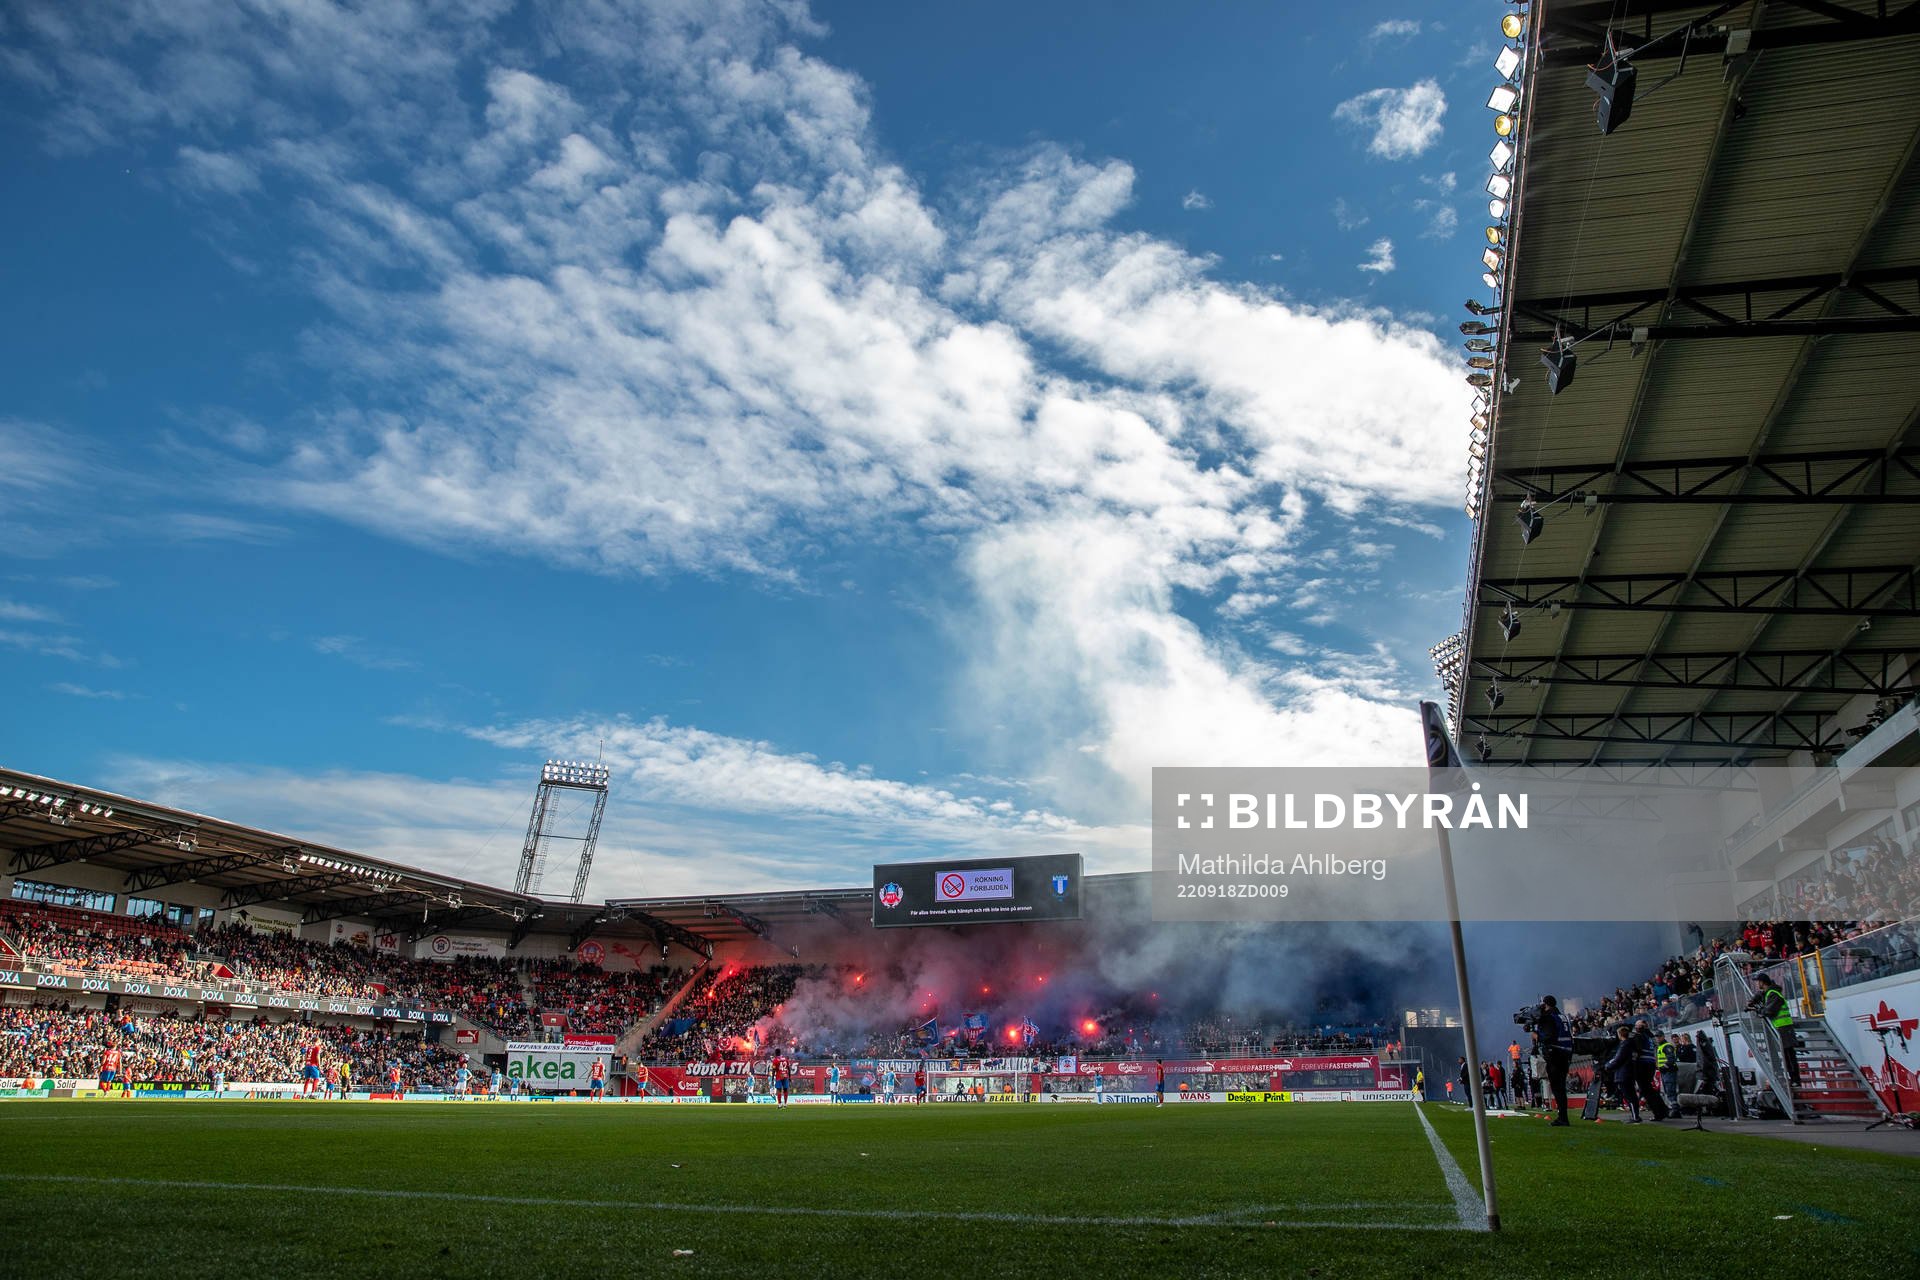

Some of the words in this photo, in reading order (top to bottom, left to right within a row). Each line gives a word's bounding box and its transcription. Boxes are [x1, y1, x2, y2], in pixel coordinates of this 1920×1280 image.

[0, 971, 20, 984] OXA
[38, 974, 67, 988] DOXA
[82, 978, 110, 991] DOXA
[125, 982, 151, 994] DOXA
[164, 986, 188, 998] DOXA
[202, 990, 224, 1001] DOXA
[236, 994, 258, 1004] DOXA
[269, 997, 290, 1008] DOXA
[300, 1000, 318, 1010] DOXA
[329, 1003, 348, 1013] DOXA
[357, 1006, 374, 1016] DOXA
[384, 1008, 400, 1018] DOXA
[408, 1010, 424, 1020] DOXA
[433, 1013, 448, 1022] DOXA
[107, 1053, 117, 1063] 44
[507, 1055, 576, 1080] akea
[779, 1062, 787, 1071] 42
[1080, 1063, 1105, 1074] Carlsberg
[1118, 1063, 1143, 1073] Carlsberg
[57, 1079, 77, 1088] Solid
[1378, 1080, 1400, 1088] PUMA
[1180, 1092, 1211, 1100] WANS
[1228, 1093, 1256, 1103] Design
[1264, 1092, 1285, 1102] Print
[1362, 1093, 1411, 1101] UNISPORT
